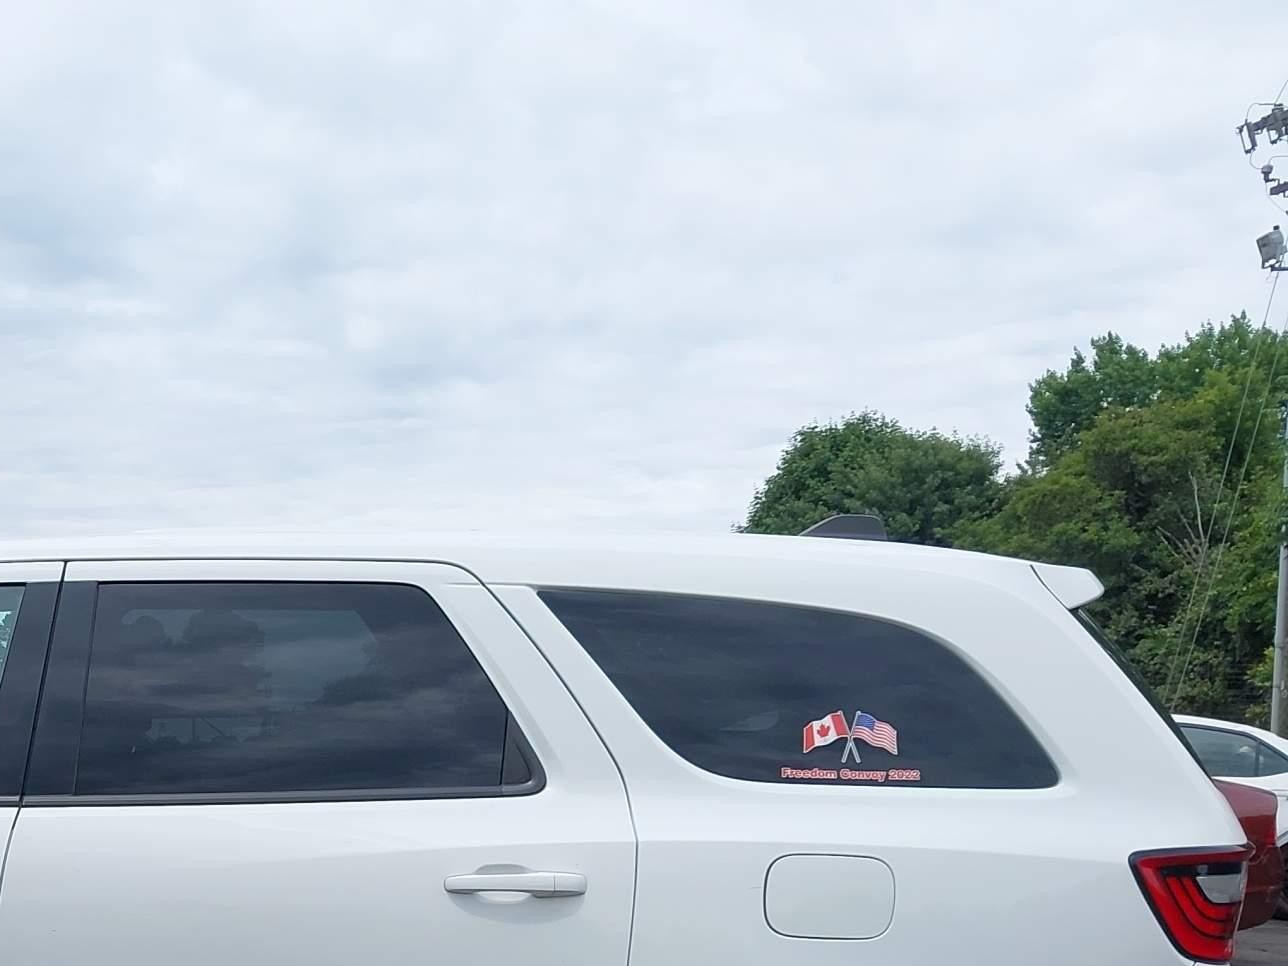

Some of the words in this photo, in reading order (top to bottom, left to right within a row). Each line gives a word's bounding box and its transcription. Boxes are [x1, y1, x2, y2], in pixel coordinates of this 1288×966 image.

[781, 768, 837, 779] Freedom
[840, 769, 886, 782] Convoy
[888, 770, 920, 780] 2022
